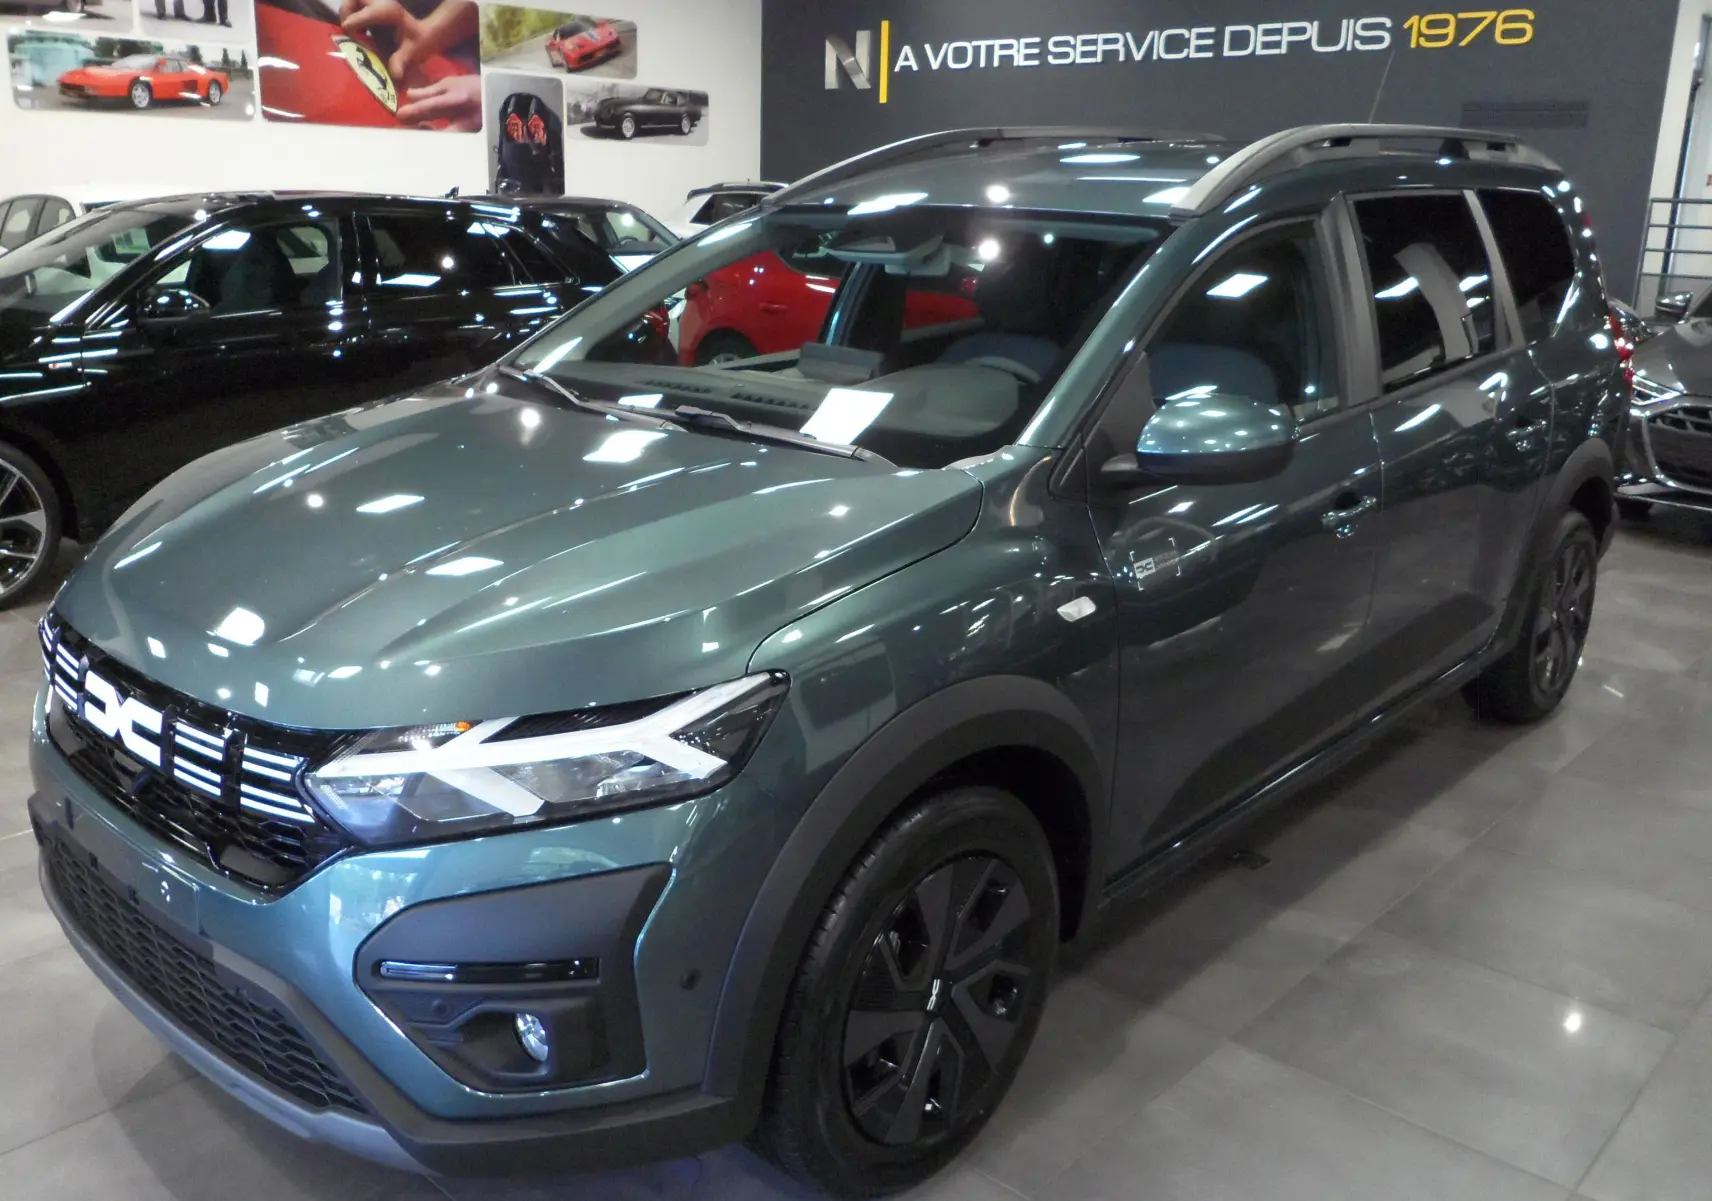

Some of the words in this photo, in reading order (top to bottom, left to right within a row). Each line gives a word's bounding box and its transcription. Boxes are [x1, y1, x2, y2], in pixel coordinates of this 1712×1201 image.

[824, 30, 871, 90] N
[894, 45, 919, 72] A
[924, 37, 1041, 71] VOTRE
[1047, 27, 1216, 66] SERVICE
[1222, 17, 1392, 57] DEPUIS
[1403, 9, 1535, 48] 1976
